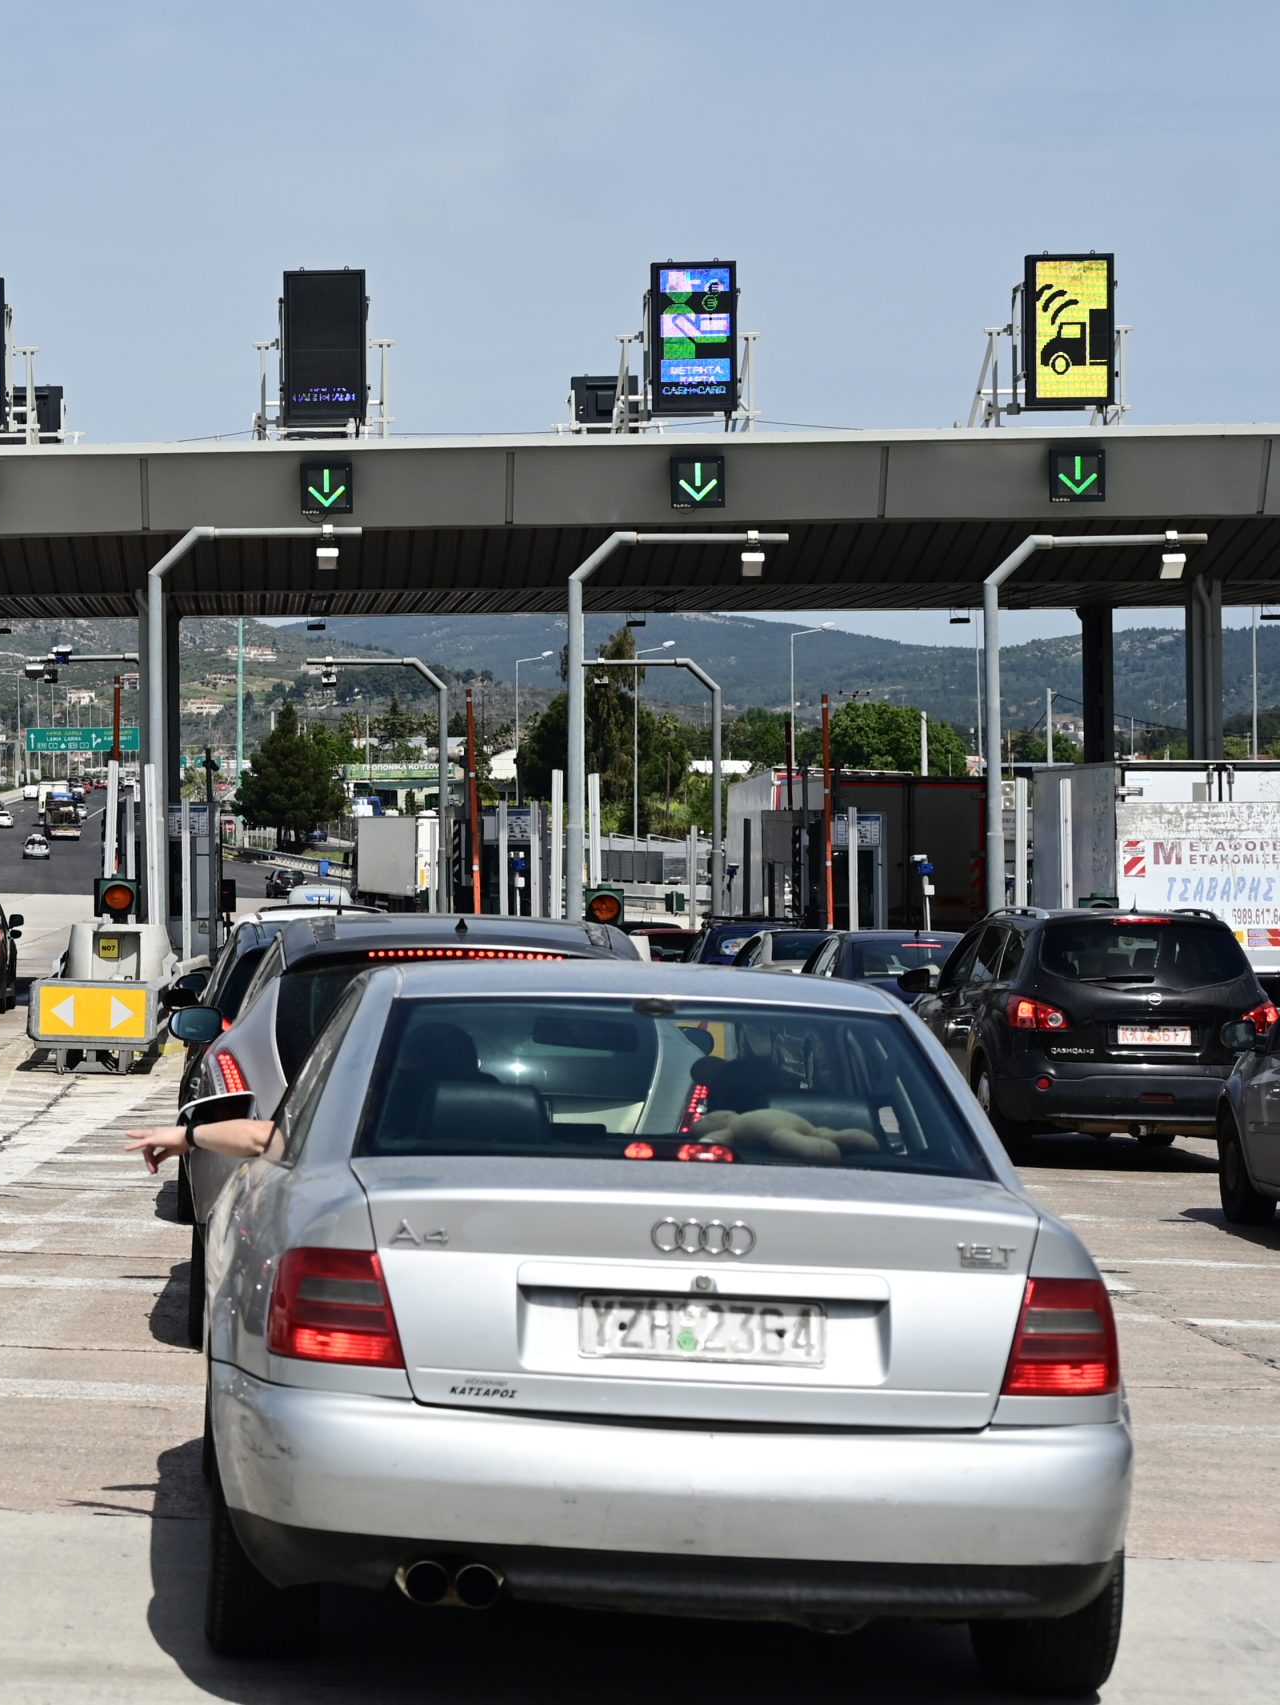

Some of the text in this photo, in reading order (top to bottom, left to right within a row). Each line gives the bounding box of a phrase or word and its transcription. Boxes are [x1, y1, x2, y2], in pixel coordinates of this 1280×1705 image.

[1166, 876, 1276, 903] ΤΣΑΒΑΡΗΣ
[389, 1219, 449, 1245] A4
[449, 1386, 518, 1399] ΚΑΤΣΑΡΟΣ
